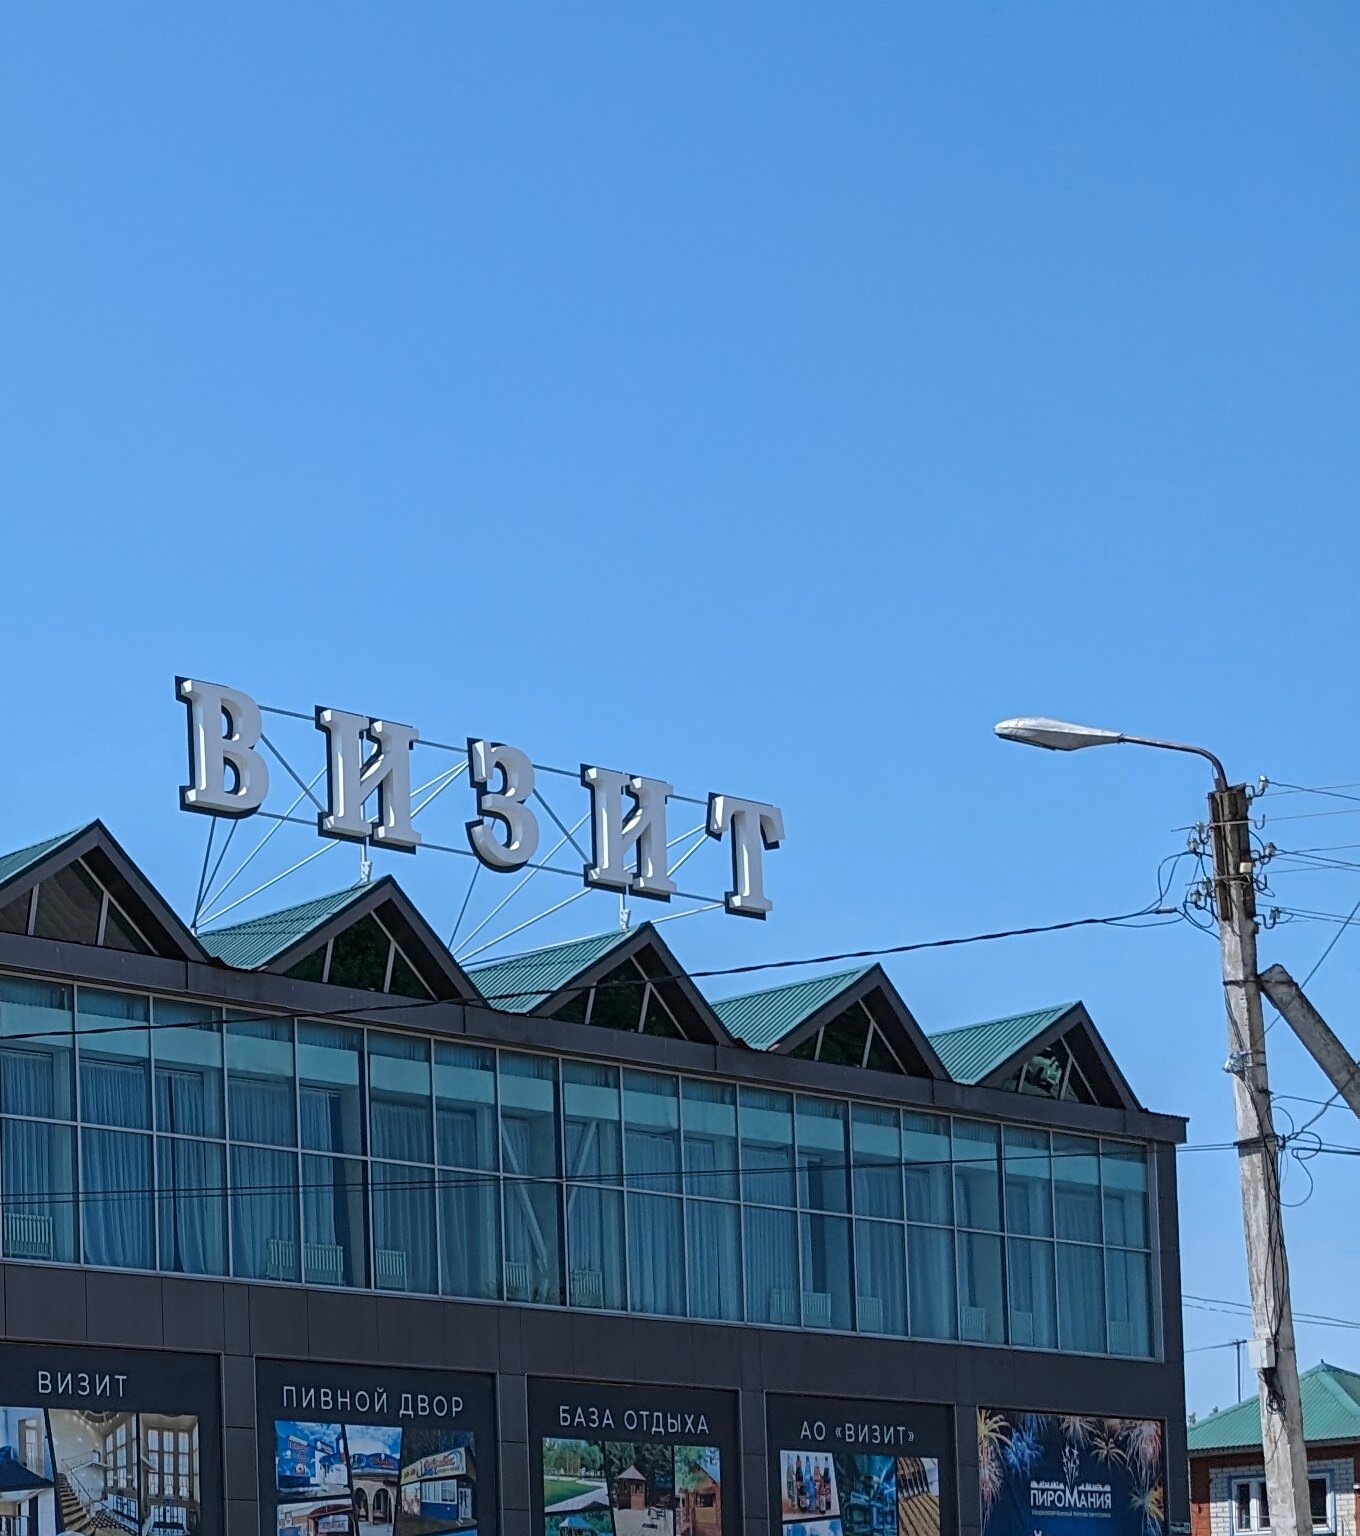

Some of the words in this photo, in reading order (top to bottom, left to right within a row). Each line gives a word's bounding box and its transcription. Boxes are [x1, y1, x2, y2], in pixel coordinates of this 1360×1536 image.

[175, 676, 785, 921] ВИЗИТ
[37, 1370, 128, 1398] ВИЗИТ
[282, 1385, 388, 1414] ПИВНОЙ
[399, 1393, 464, 1419] ДВОР
[559, 1405, 615, 1429] БАЗА
[624, 1410, 710, 1436] ОТДЫХА
[800, 1420, 826, 1441] АО
[835, 1422, 915, 1445] «ВИЗИТ»
